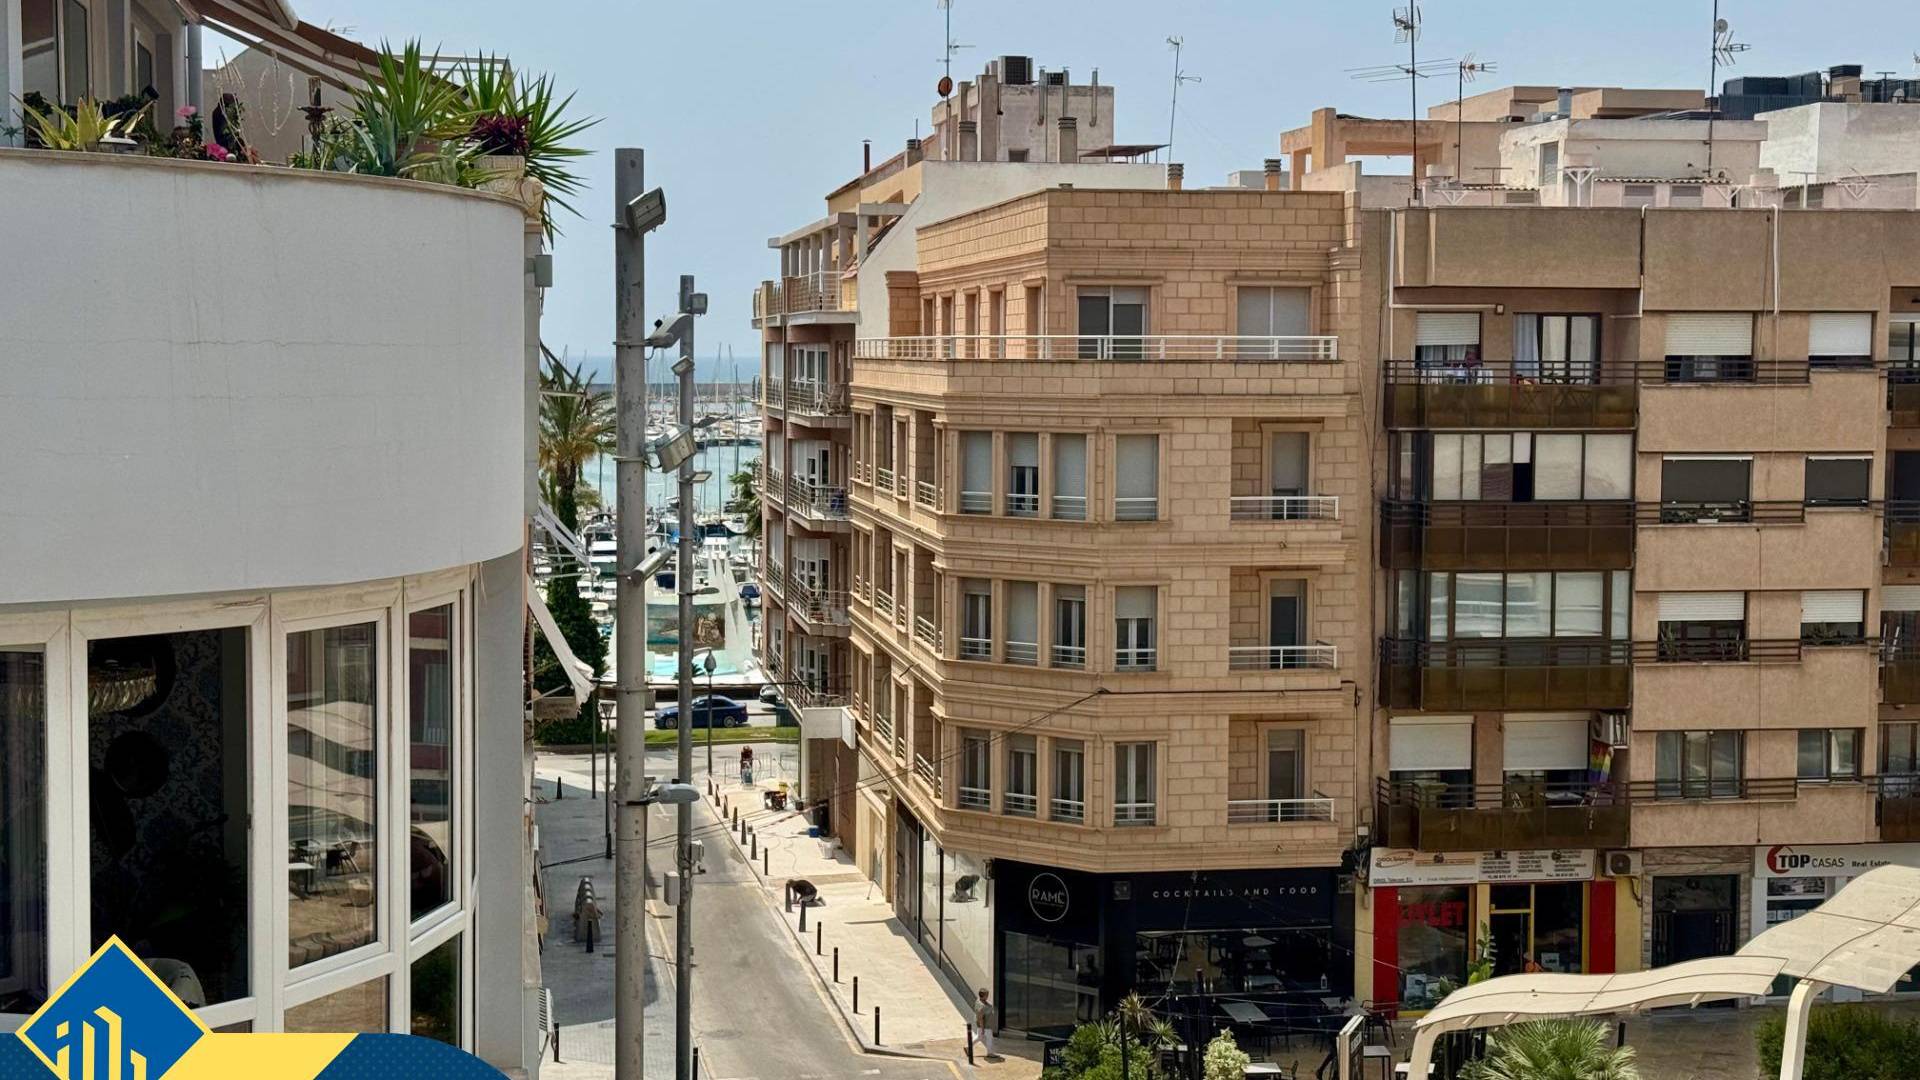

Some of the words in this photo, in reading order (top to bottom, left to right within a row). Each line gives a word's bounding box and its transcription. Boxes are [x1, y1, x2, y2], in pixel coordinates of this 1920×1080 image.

[1779, 855, 1810, 868] TOP
[1812, 857, 1845, 868] CASAS
[1152, 889, 1234, 898] COCKTAILS
[1244, 887, 1269, 896] AND
[1279, 886, 1317, 895] FOOD
